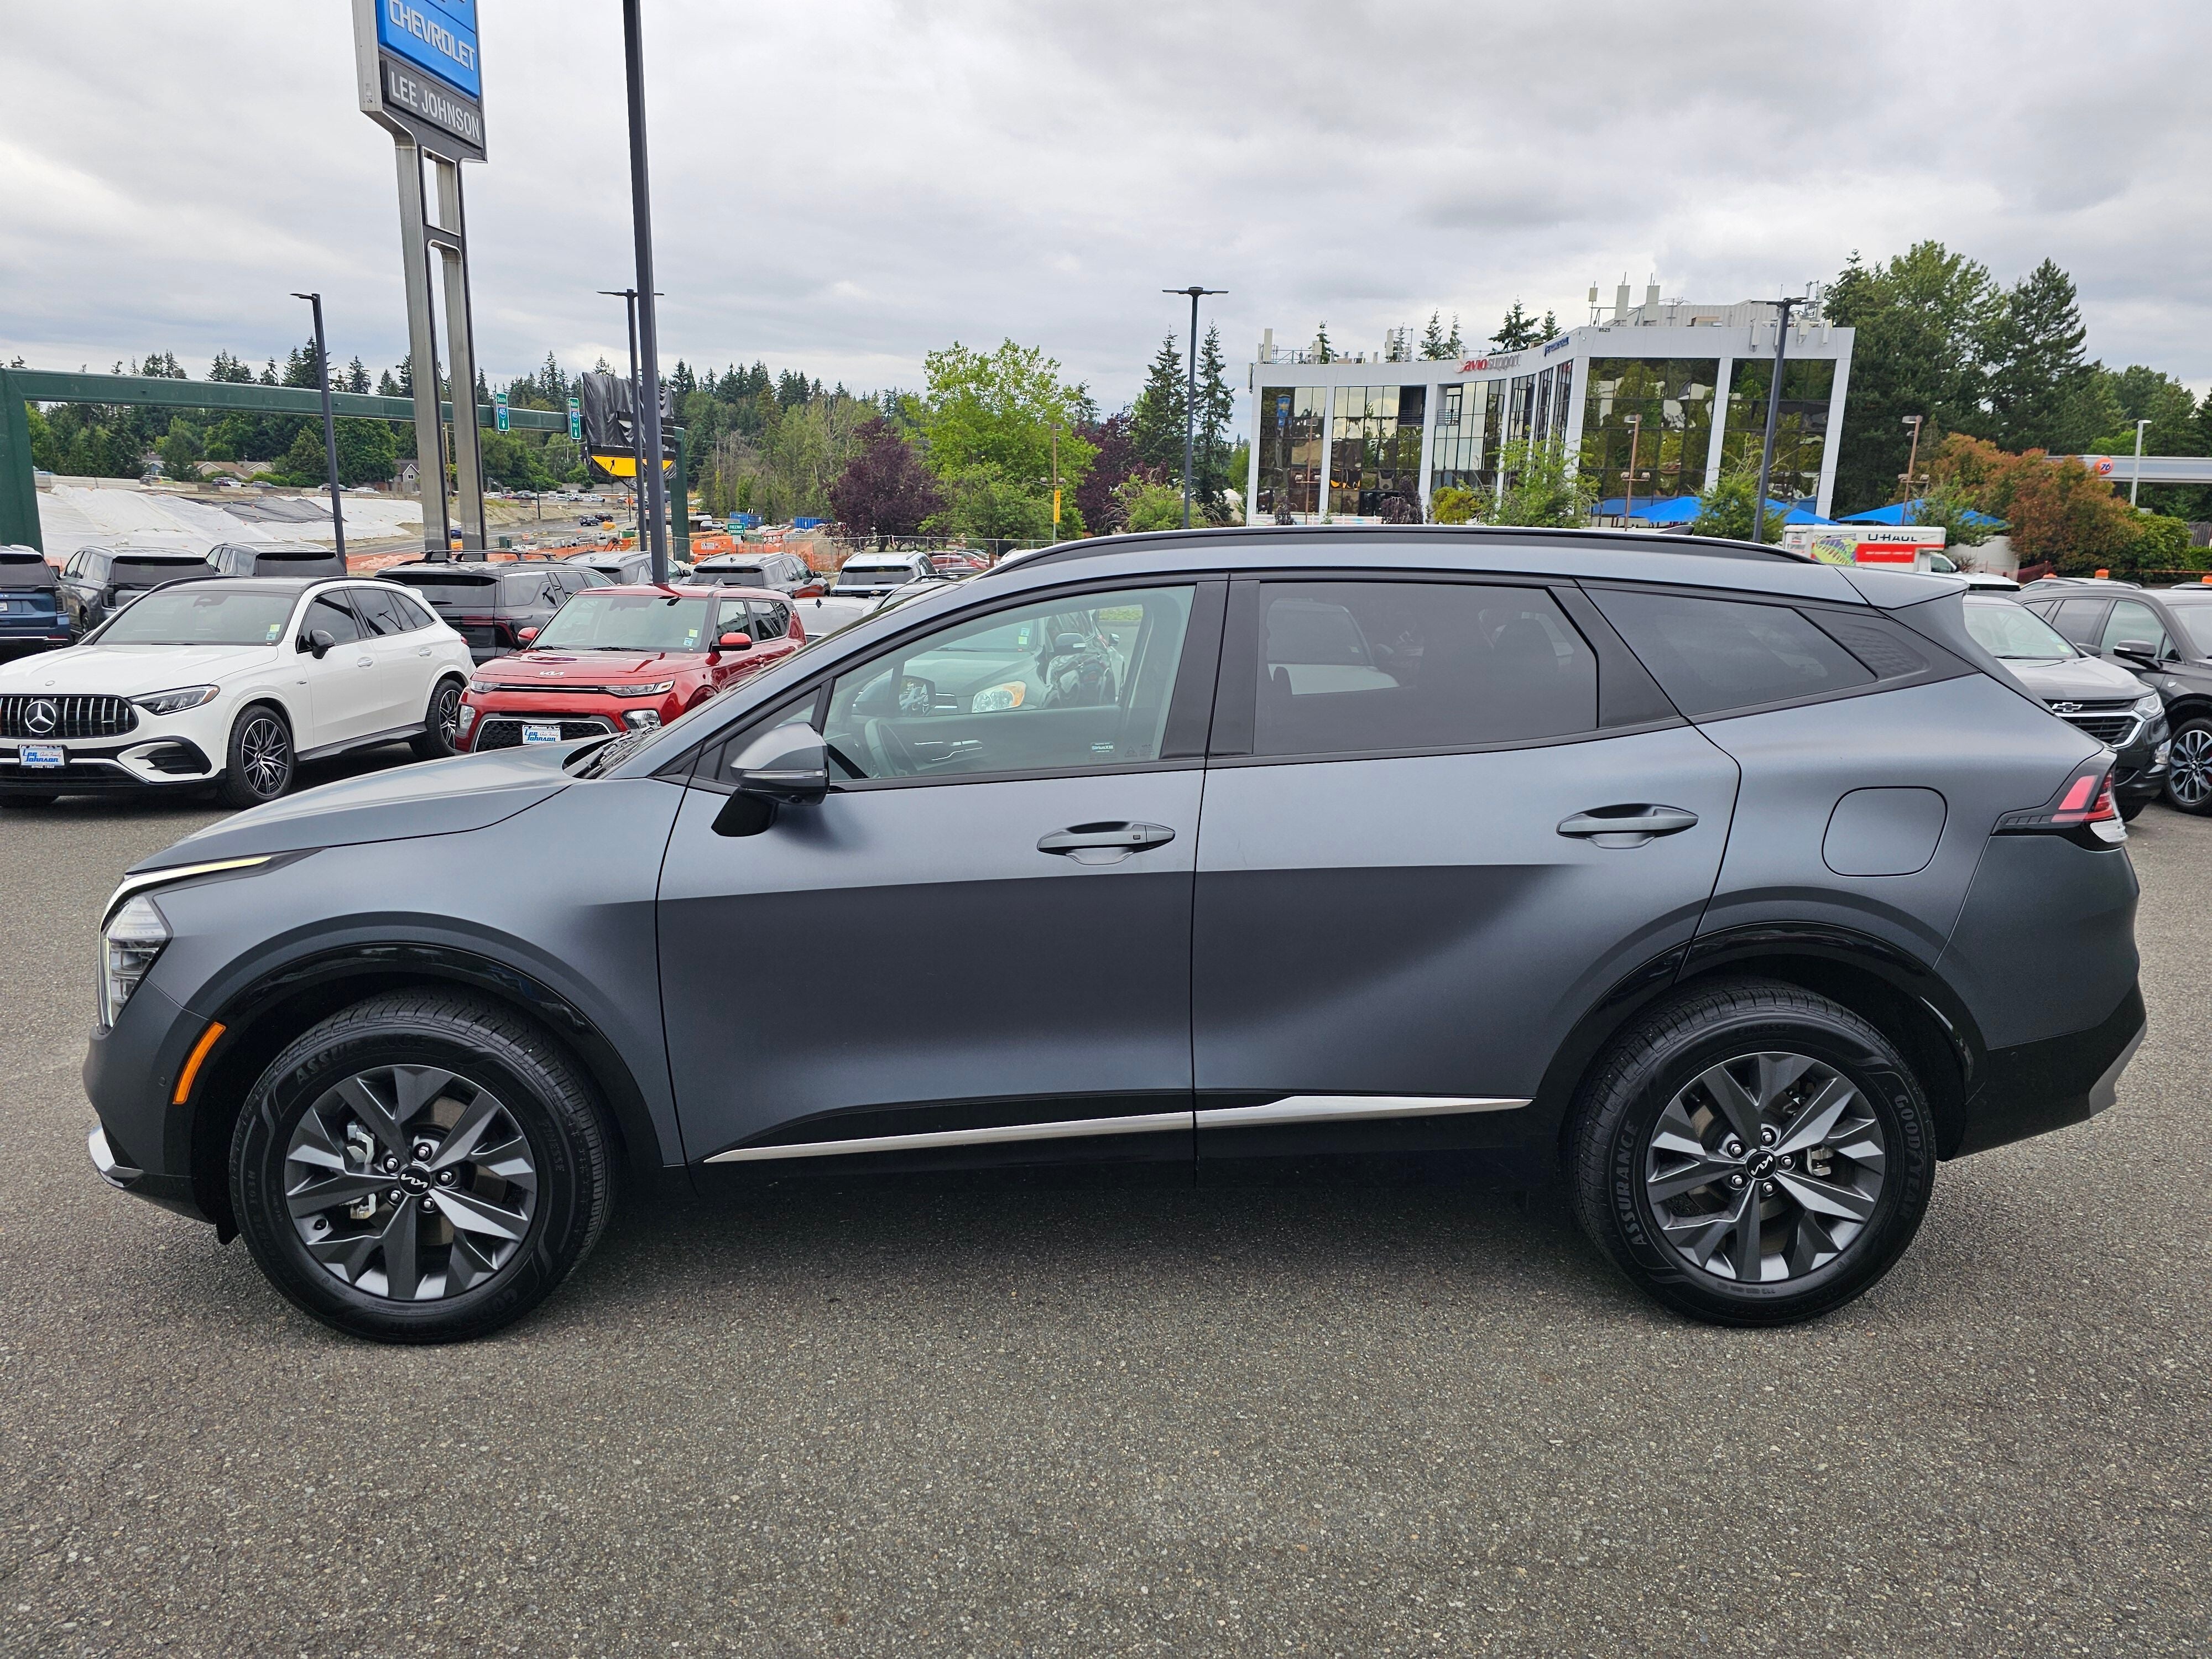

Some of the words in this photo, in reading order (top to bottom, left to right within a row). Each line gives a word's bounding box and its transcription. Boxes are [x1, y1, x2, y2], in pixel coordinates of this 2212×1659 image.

[389, 0, 475, 71] CHEVROLET
[391, 71, 418, 107] LEE
[421, 90, 480, 140] JOHNSON
[1867, 533, 1918, 542] U-HAUL
[24, 753, 59, 763] Johnson
[1616, 1120, 1647, 1245] ASSURANCE
